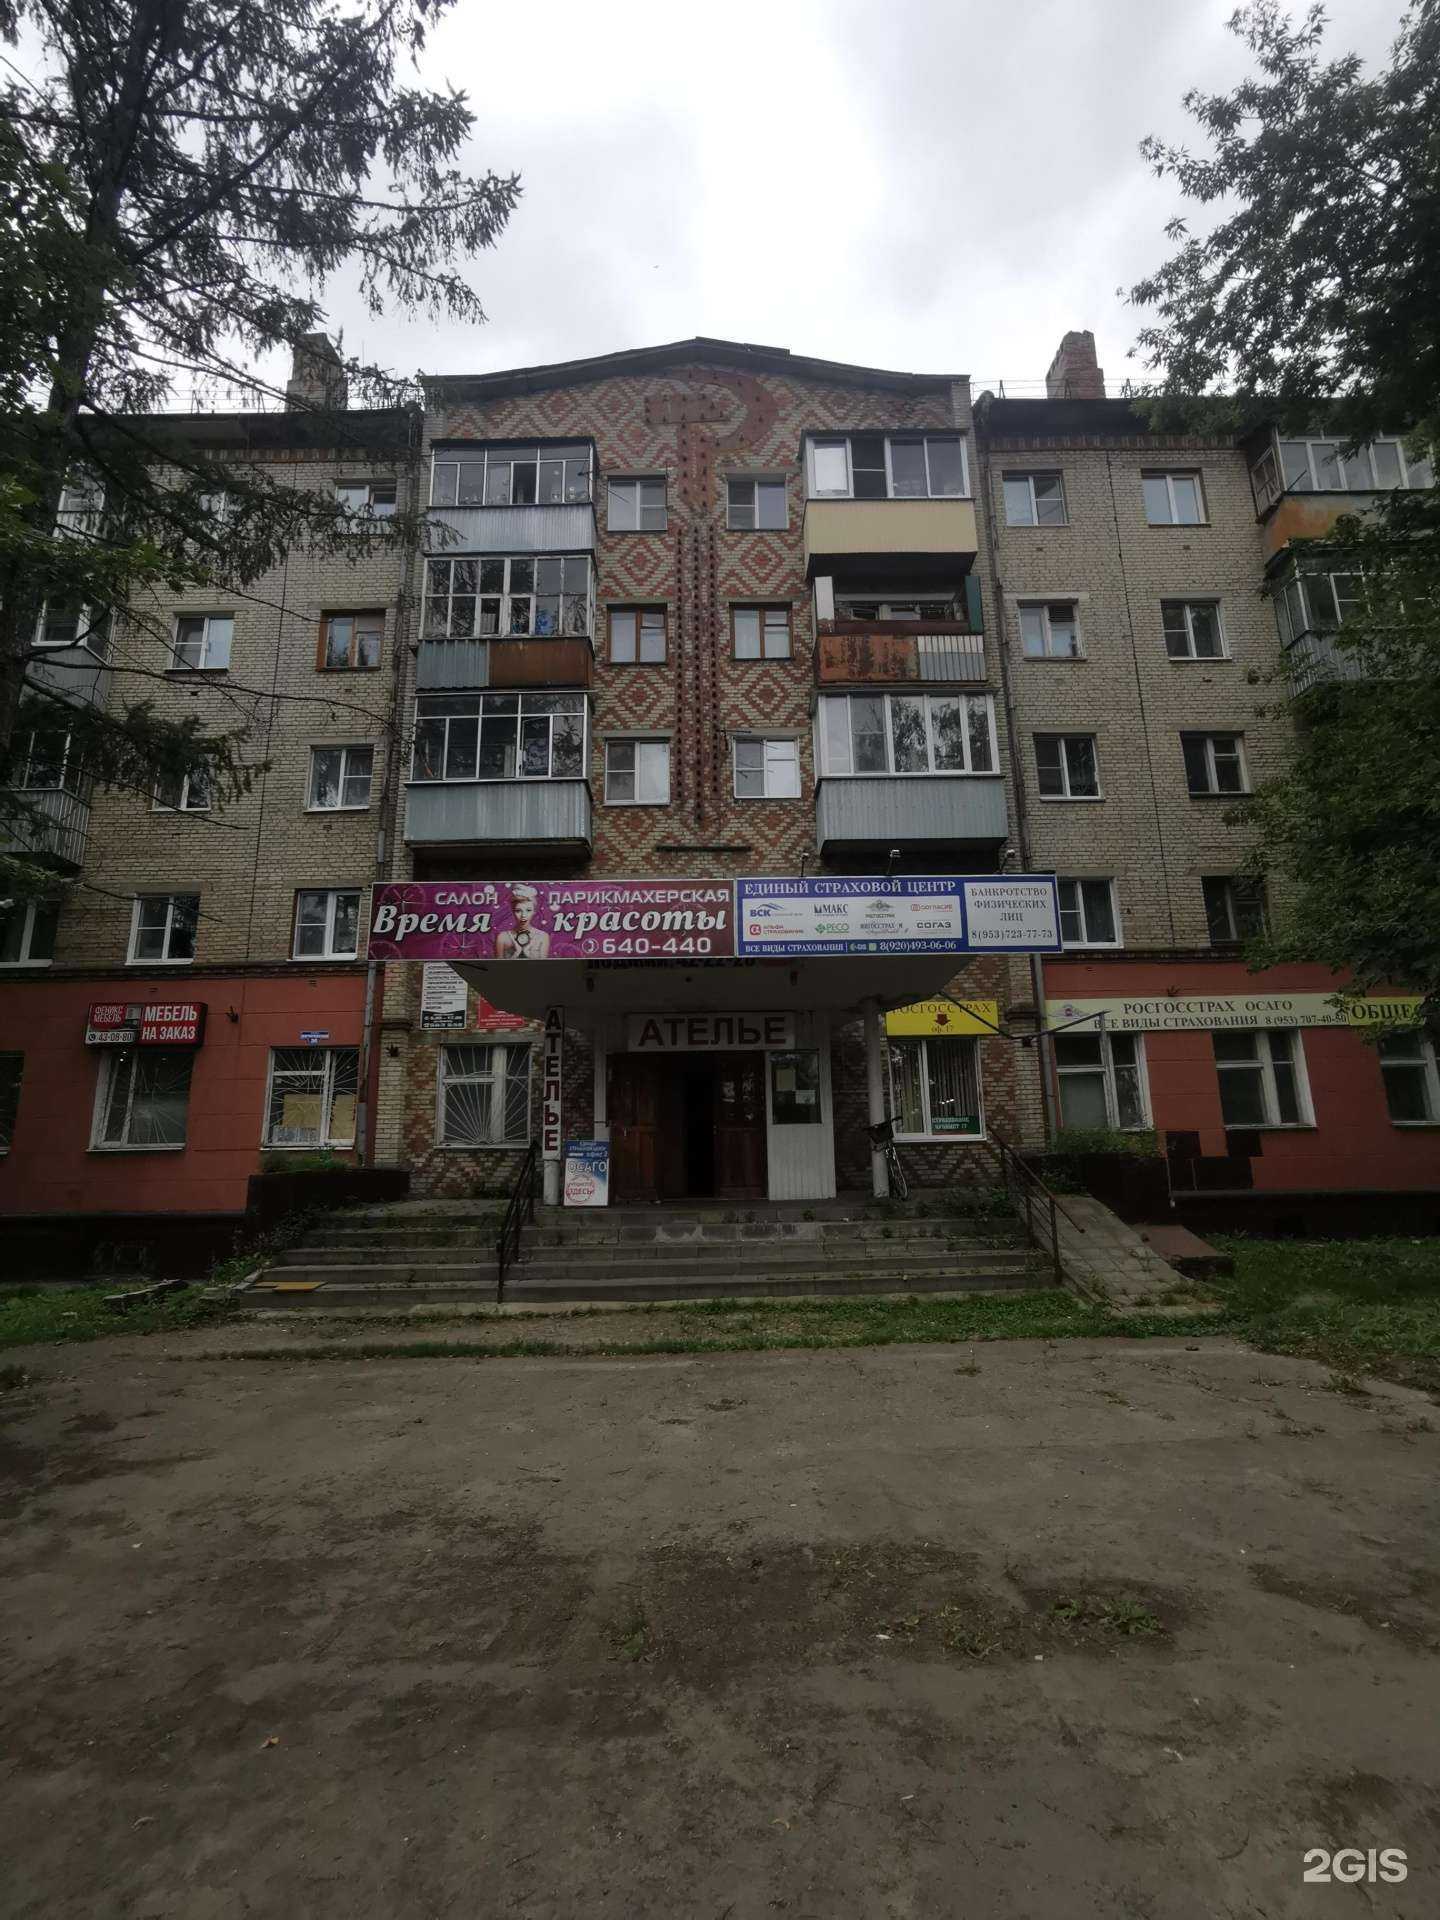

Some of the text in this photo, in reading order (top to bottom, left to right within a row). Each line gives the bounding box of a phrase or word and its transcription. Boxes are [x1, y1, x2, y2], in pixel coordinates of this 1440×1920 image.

[745, 879, 956, 896] ЕДИНЫЙ СТРАХОВОЙ ЦЕНТР
[970, 888, 1047, 897] БАНКРОТСТВО
[435, 889, 730, 905] САЛОН ПАРИКМАХЕРСКАЯ
[974, 900, 1047, 910] ФИЗИЧЕСКИХ
[373, 905, 727, 942] Время красоты
[1000, 912, 1023, 922] ЛИЦ
[602, 937, 712, 954] 640-440
[745, 945, 760, 953] ВСЕ
[762, 945, 785, 953] ВИДЫ
[788, 943, 844, 953] СТРАХОВАНИЯ
[145, 1006, 198, 1022] МЕБЕЛЬ
[1124, 1000, 1292, 1014] РОСГОССТРАХ ОСАГО
[1094, 1018, 1119, 1029] ВЕ
[1122, 1017, 1160, 1029] ВИДЫ
[1164, 1015, 1257, 1027] СТРАХОВАНИЯ
[1265, 1016, 1272, 1024] 8
[142, 1026, 196, 1041] НА ЗАКАЗ
[638, 1016, 786, 1047] АТЕЛЬЕ
[545, 1008, 561, 1152] АТЕЛЬЕ
